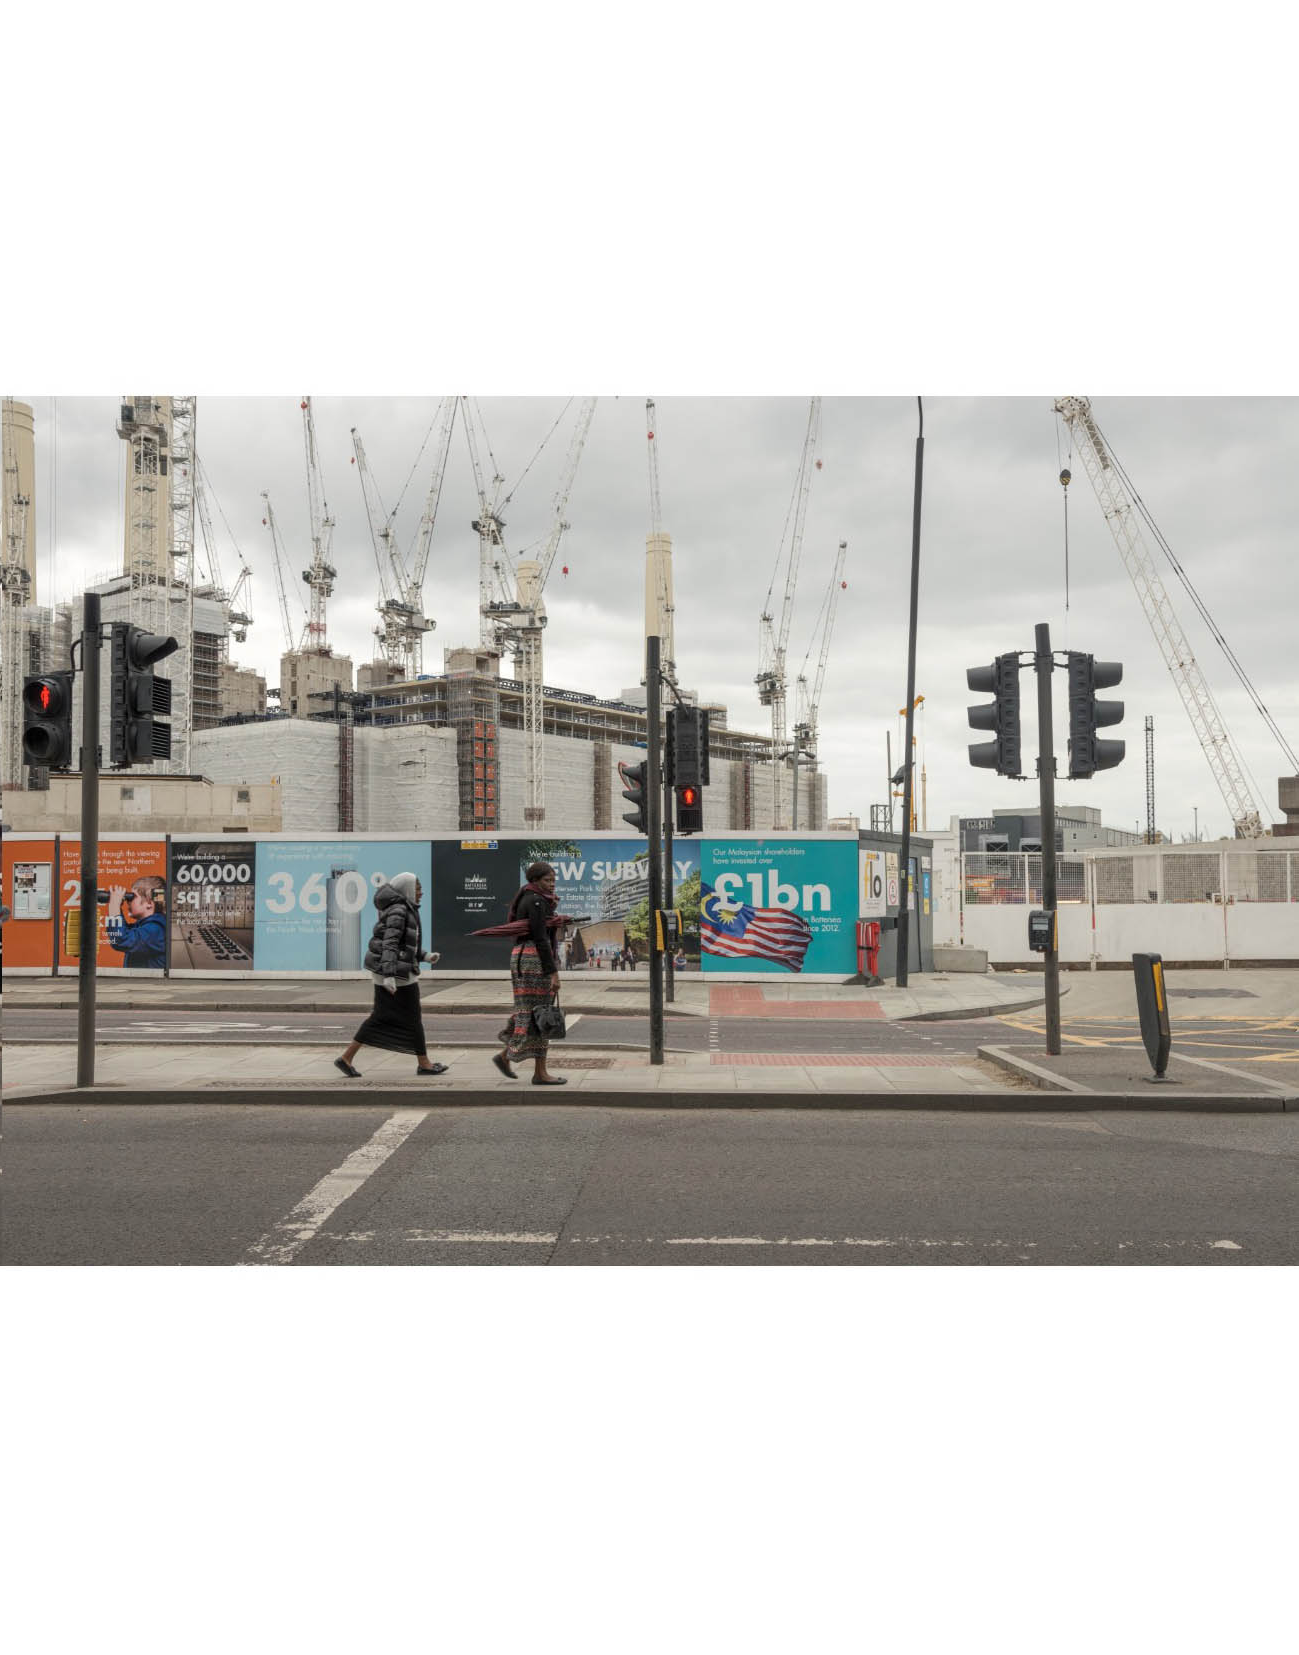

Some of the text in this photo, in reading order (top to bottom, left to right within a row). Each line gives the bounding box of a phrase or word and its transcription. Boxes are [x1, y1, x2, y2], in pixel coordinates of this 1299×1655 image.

[728, 848, 763, 857] Malaysian
[764, 848, 805, 856] shareholders
[731, 856, 757, 864] invested
[177, 863, 251, 885] 60,000
[529, 861, 586, 881] EW
[177, 885, 221, 909] sq ft
[711, 869, 831, 912] £1bn
[811, 915, 842, 923] Battersea
[803, 923, 841, 932] since 2012.
